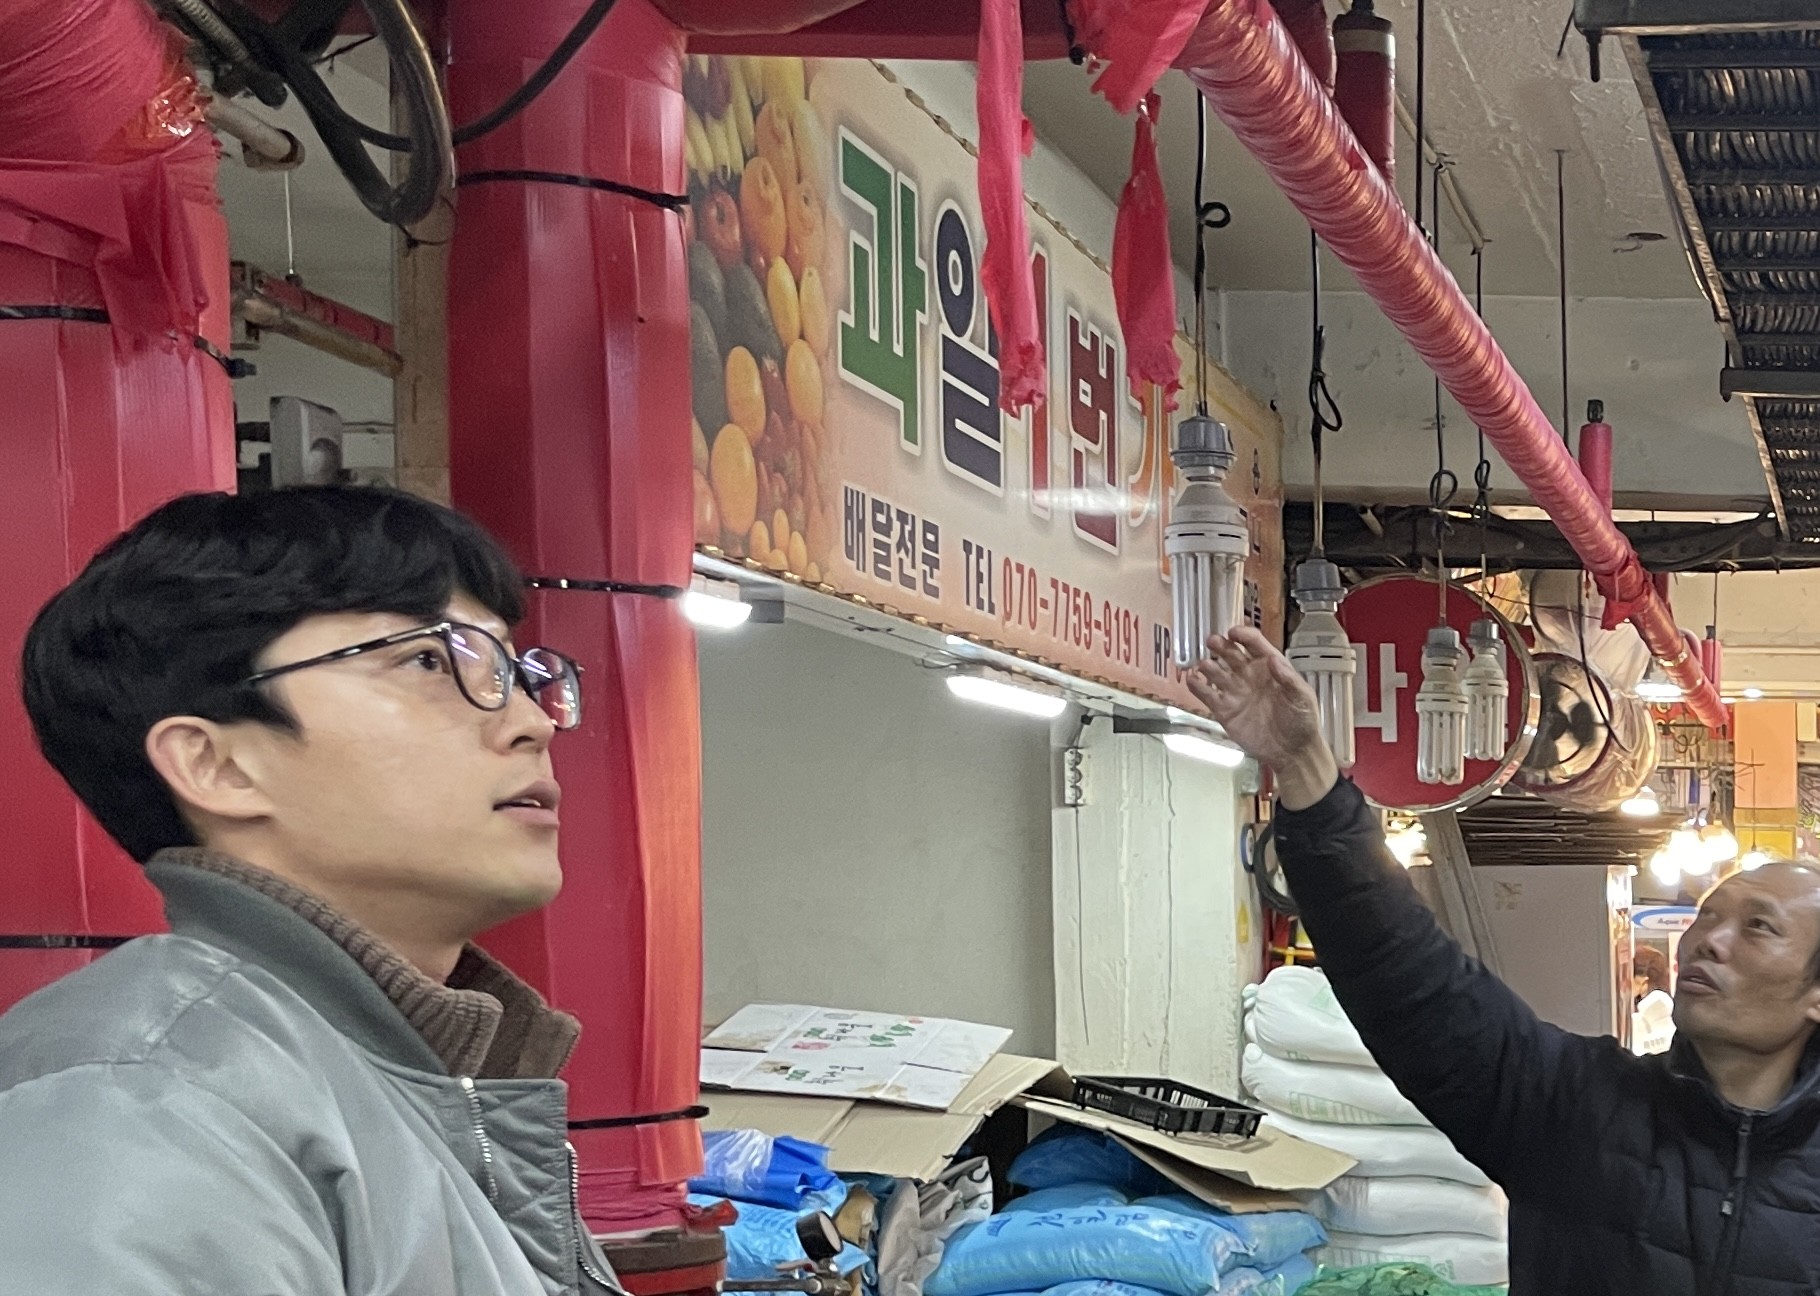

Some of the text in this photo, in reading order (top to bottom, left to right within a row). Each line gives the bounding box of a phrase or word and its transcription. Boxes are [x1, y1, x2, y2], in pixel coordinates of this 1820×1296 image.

[843, 485, 941, 601] 배달전문
[962, 537, 997, 616] TEL
[1002, 556, 1140, 669] 070-7759-9191
[1152, 621, 1171, 679] HP
